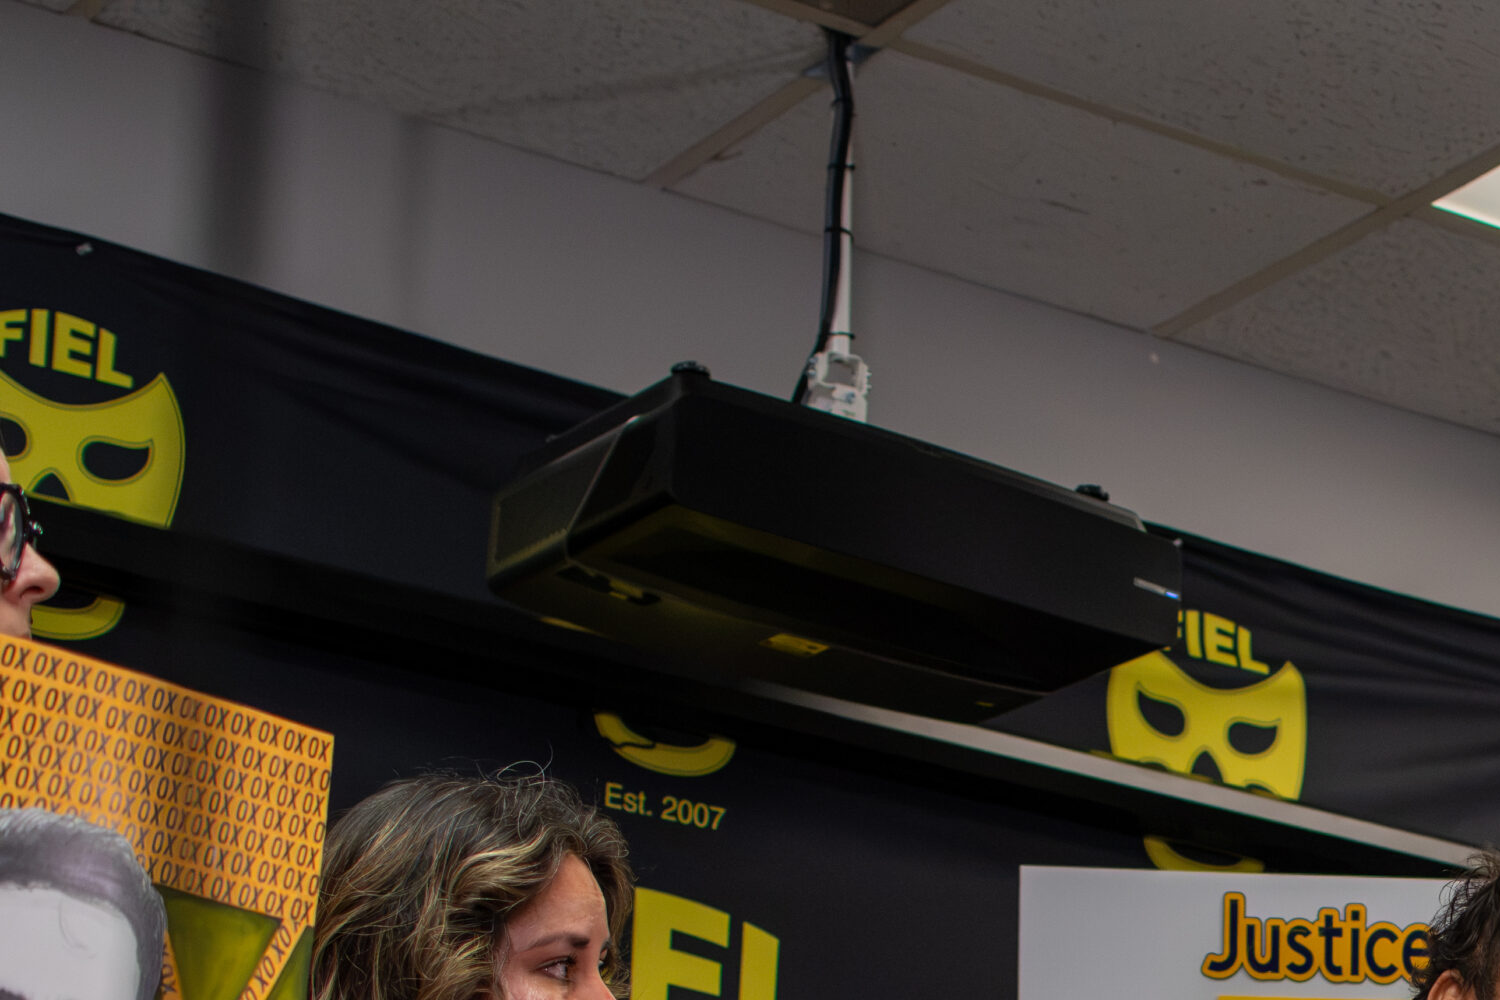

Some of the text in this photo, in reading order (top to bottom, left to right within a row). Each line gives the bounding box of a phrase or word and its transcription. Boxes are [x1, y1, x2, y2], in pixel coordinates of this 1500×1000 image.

[0, 308, 134, 388] FIEL
[1177, 609, 1270, 675] IEL
[604, 782, 727, 830] Est. 2007
[1203, 893, 1433, 982] Justice
